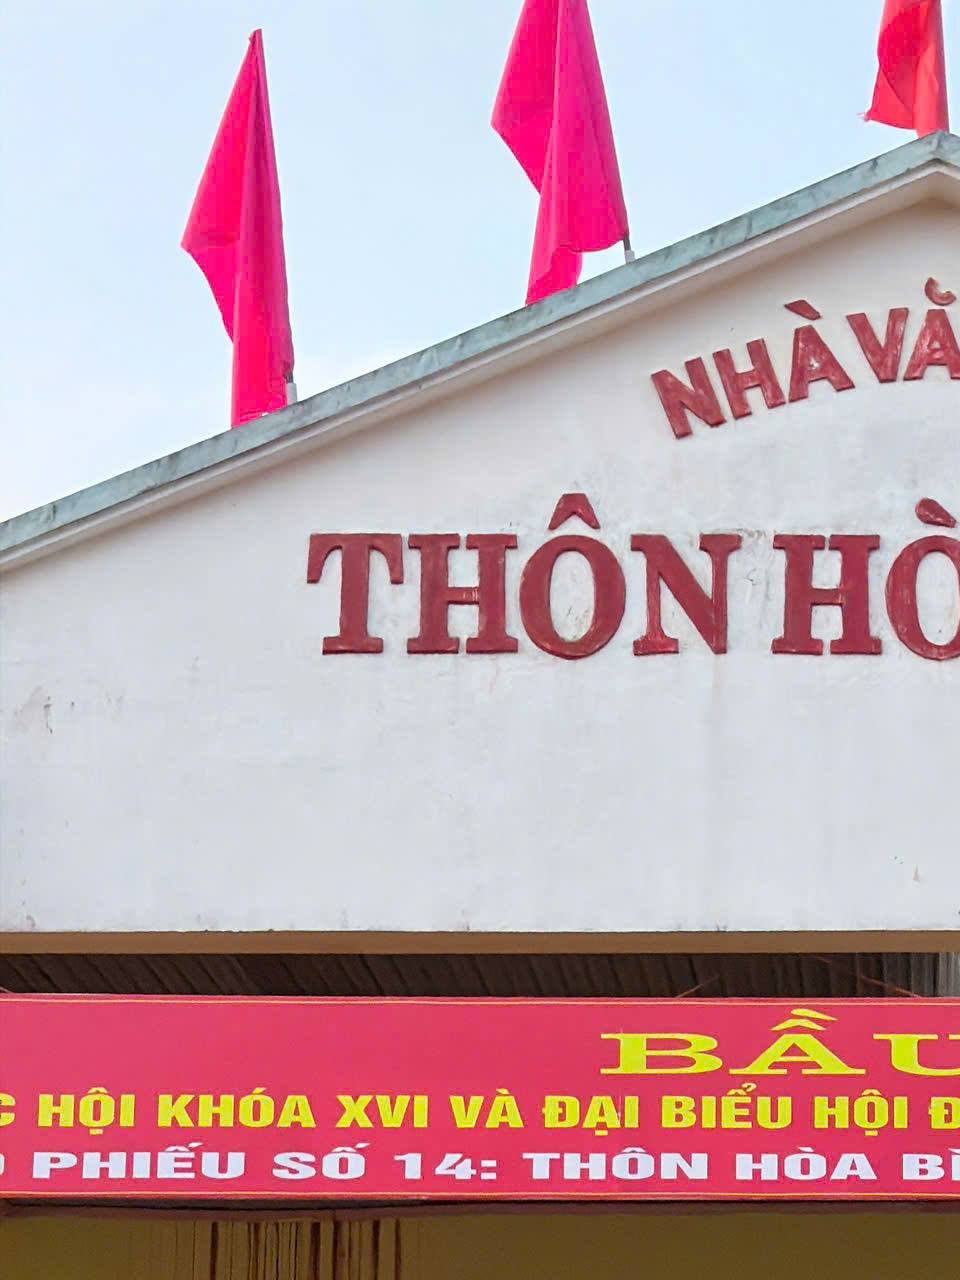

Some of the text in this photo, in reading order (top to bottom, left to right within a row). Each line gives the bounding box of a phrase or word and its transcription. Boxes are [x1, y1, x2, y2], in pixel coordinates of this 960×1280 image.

[651, 299, 855, 440] NHÀ
[306, 492, 742, 660] THÔN
[37, 1087, 136, 1135] HỘI
[157, 1087, 317, 1128] KHÓA
[335, 1094, 429, 1128] XVI
[449, 1088, 524, 1129] VÀ
[541, 1095, 639, 1136] ĐẠI
[661, 1082, 792, 1129] BIỂU
[814, 1088, 908, 1137] HỘI
[32, 1141, 246, 1179] PHIẾU
[271, 1141, 370, 1180] SỐ
[394, 1152, 497, 1180] 14:
[522, 1146, 708, 1180] THÔN
[735, 1146, 878, 1181] HÒA
